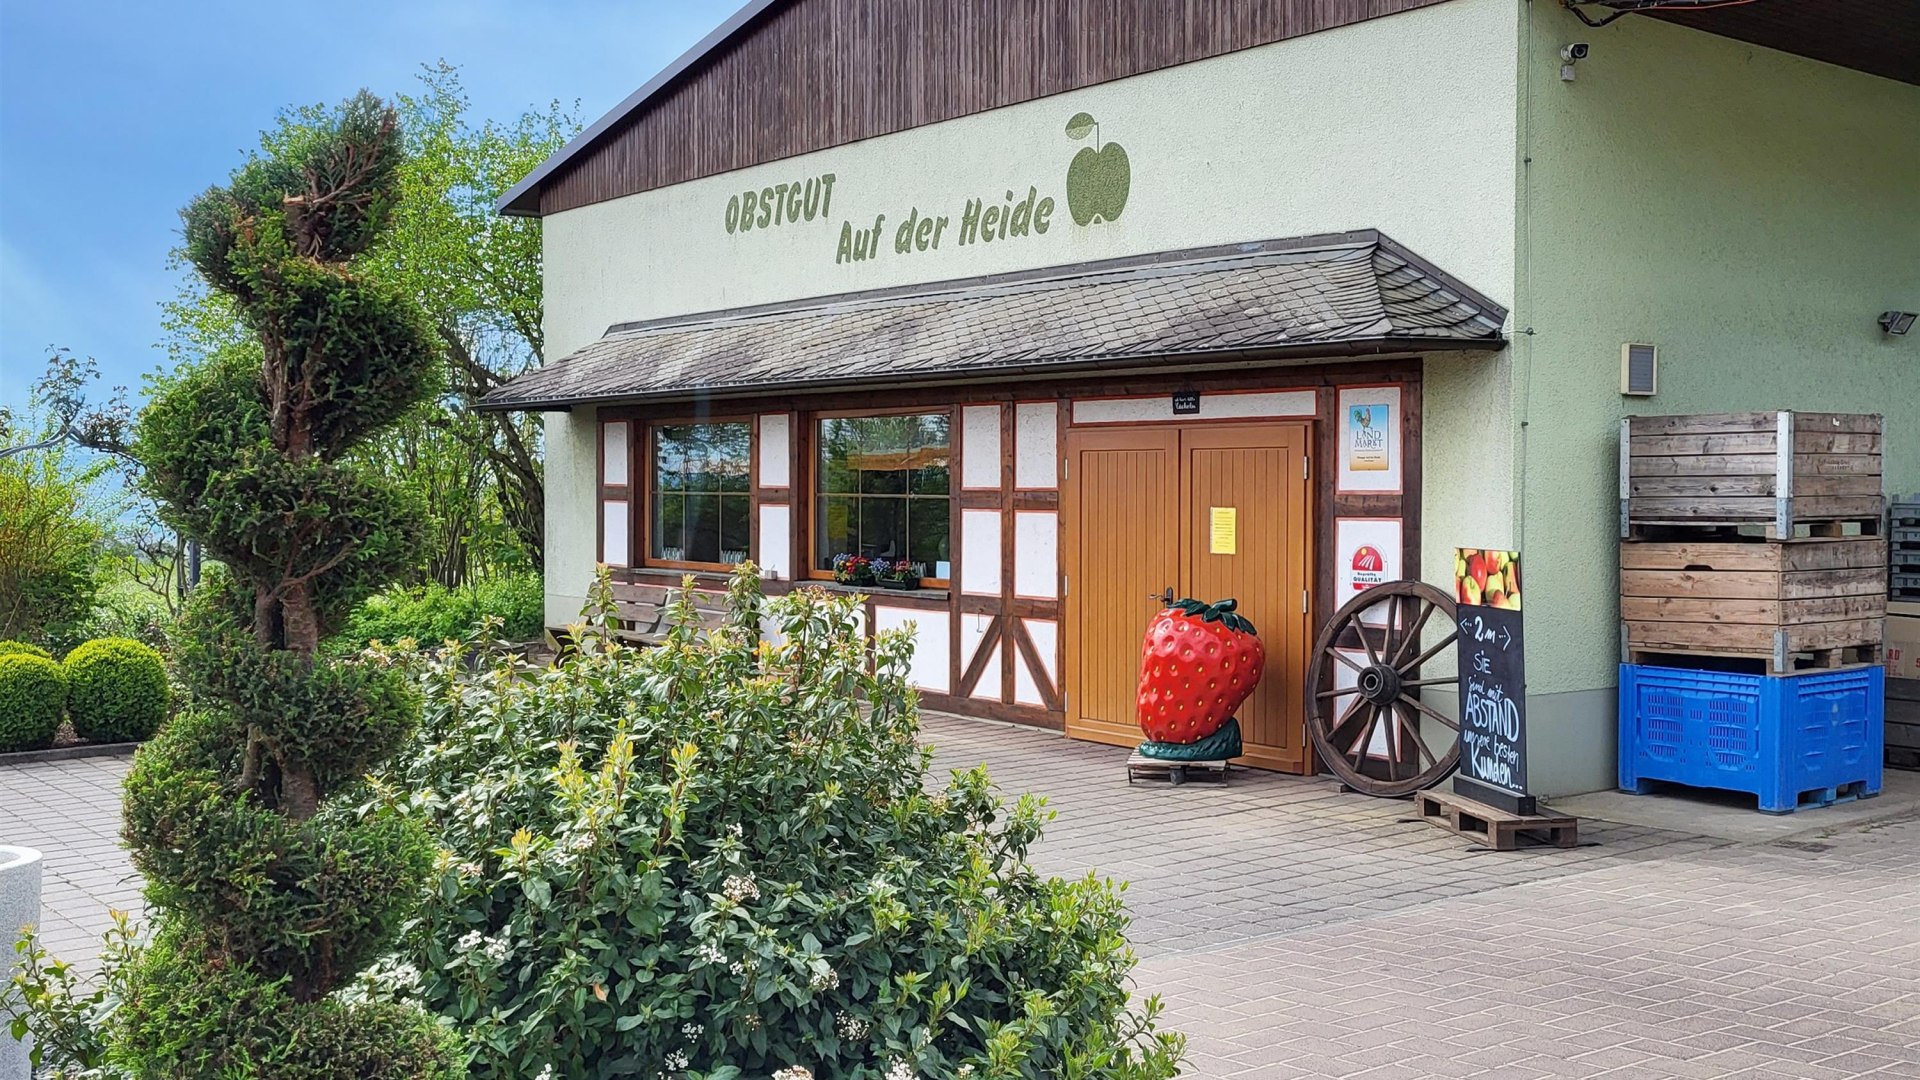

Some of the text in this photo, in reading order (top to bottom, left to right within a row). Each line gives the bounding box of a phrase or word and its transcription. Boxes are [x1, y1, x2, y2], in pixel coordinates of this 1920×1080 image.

[725, 173, 836, 235] OBSTGUT
[836, 185, 1055, 264] Auf der Heide
[1354, 439, 1384, 449] MARKT
[1356, 430, 1382, 440] LAND
[1487, 683, 1504, 703] mit
[1465, 692, 1520, 743] ABSTAND
[1494, 734, 1519, 773] besten
